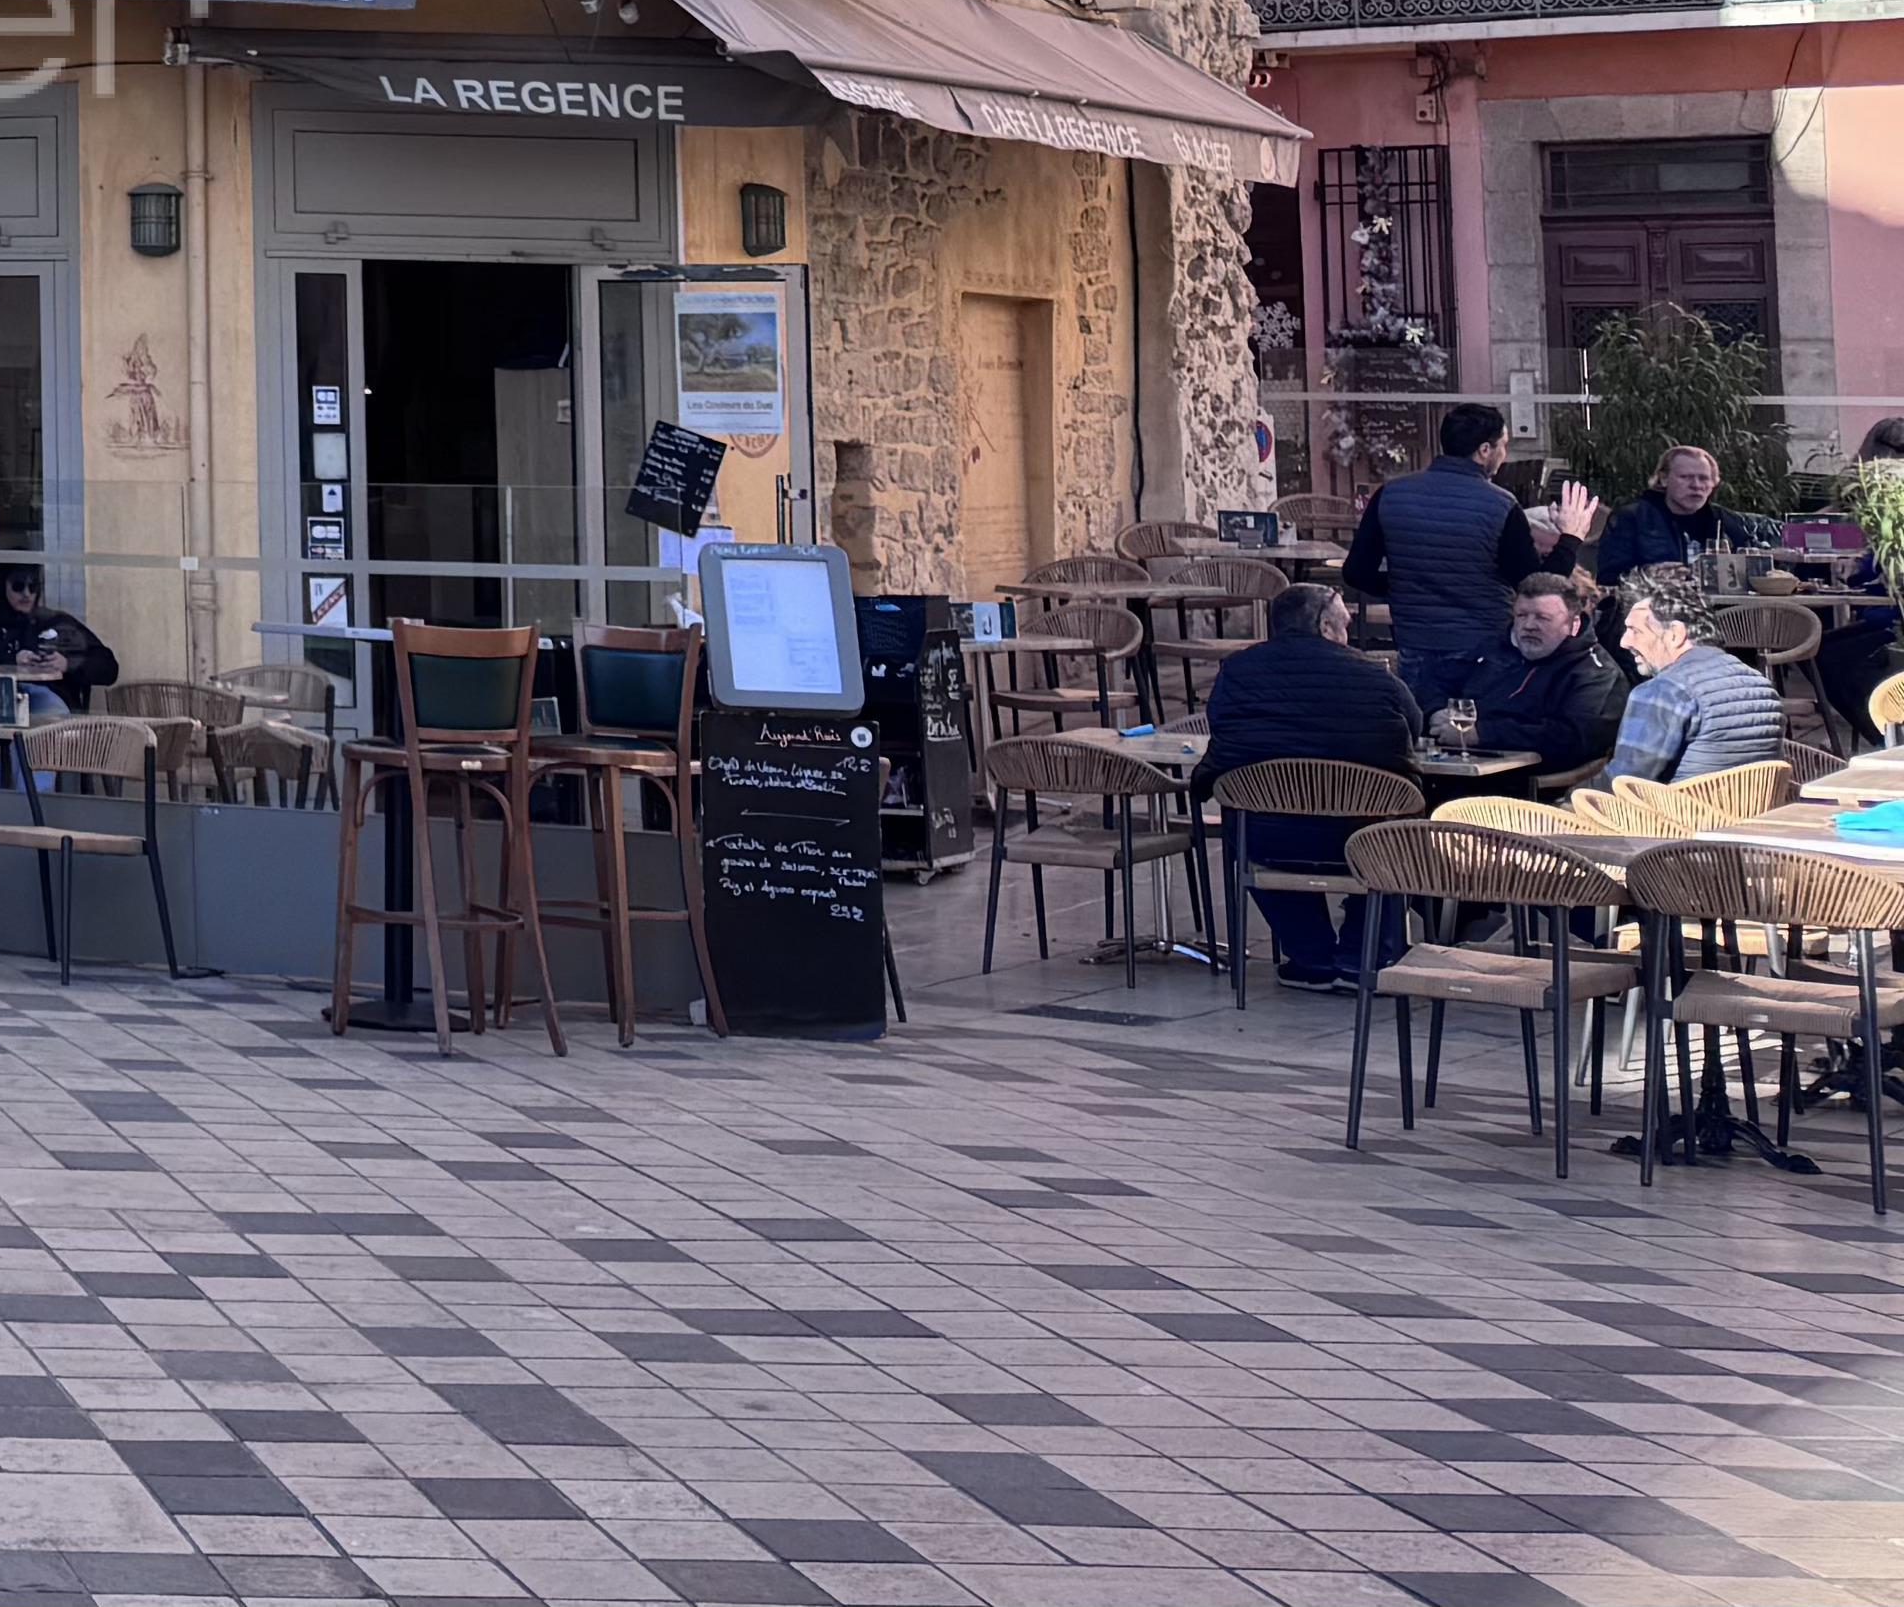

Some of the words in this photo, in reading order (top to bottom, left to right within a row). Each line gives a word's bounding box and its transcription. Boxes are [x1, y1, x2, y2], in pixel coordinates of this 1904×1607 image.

[378, 75, 448, 108] LA
[452, 78, 685, 122] REGENCE
[1060, 112, 1145, 158] REGENCE
[1172, 122, 1233, 174] GLACIER
